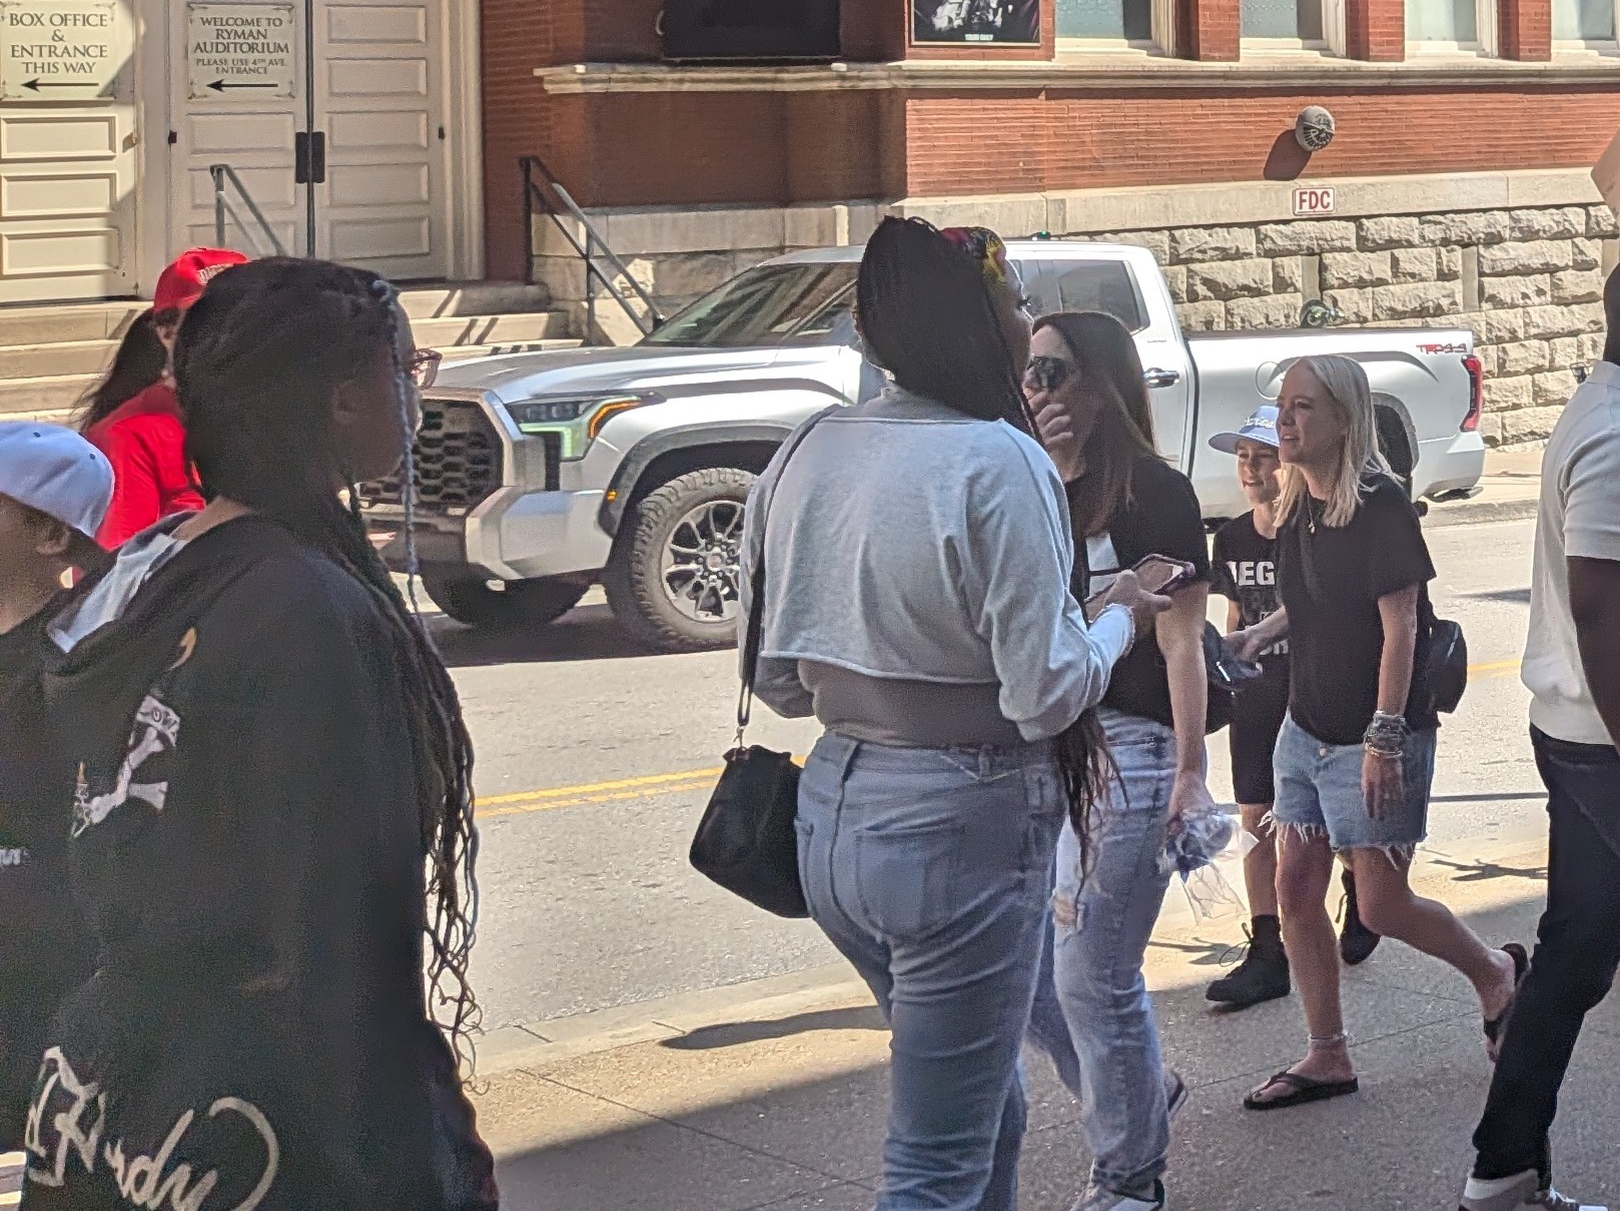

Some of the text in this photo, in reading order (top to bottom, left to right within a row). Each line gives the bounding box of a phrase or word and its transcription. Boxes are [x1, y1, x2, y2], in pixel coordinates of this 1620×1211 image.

[9, 12, 108, 27] BOX OFFICE
[200, 16, 283, 27] WELCOME TO
[51, 28, 66, 42] &
[215, 29, 268, 40] RYMAN
[11, 44, 108, 58] ENTRANCE
[193, 42, 290, 54] AUDITORIUM
[22, 61, 97, 74] THIS WAY
[196, 58, 228, 67] PLEASE
[232, 58, 249, 67] USE
[216, 66, 268, 75] ENTRANCE
[1298, 190, 1331, 210] FDC
